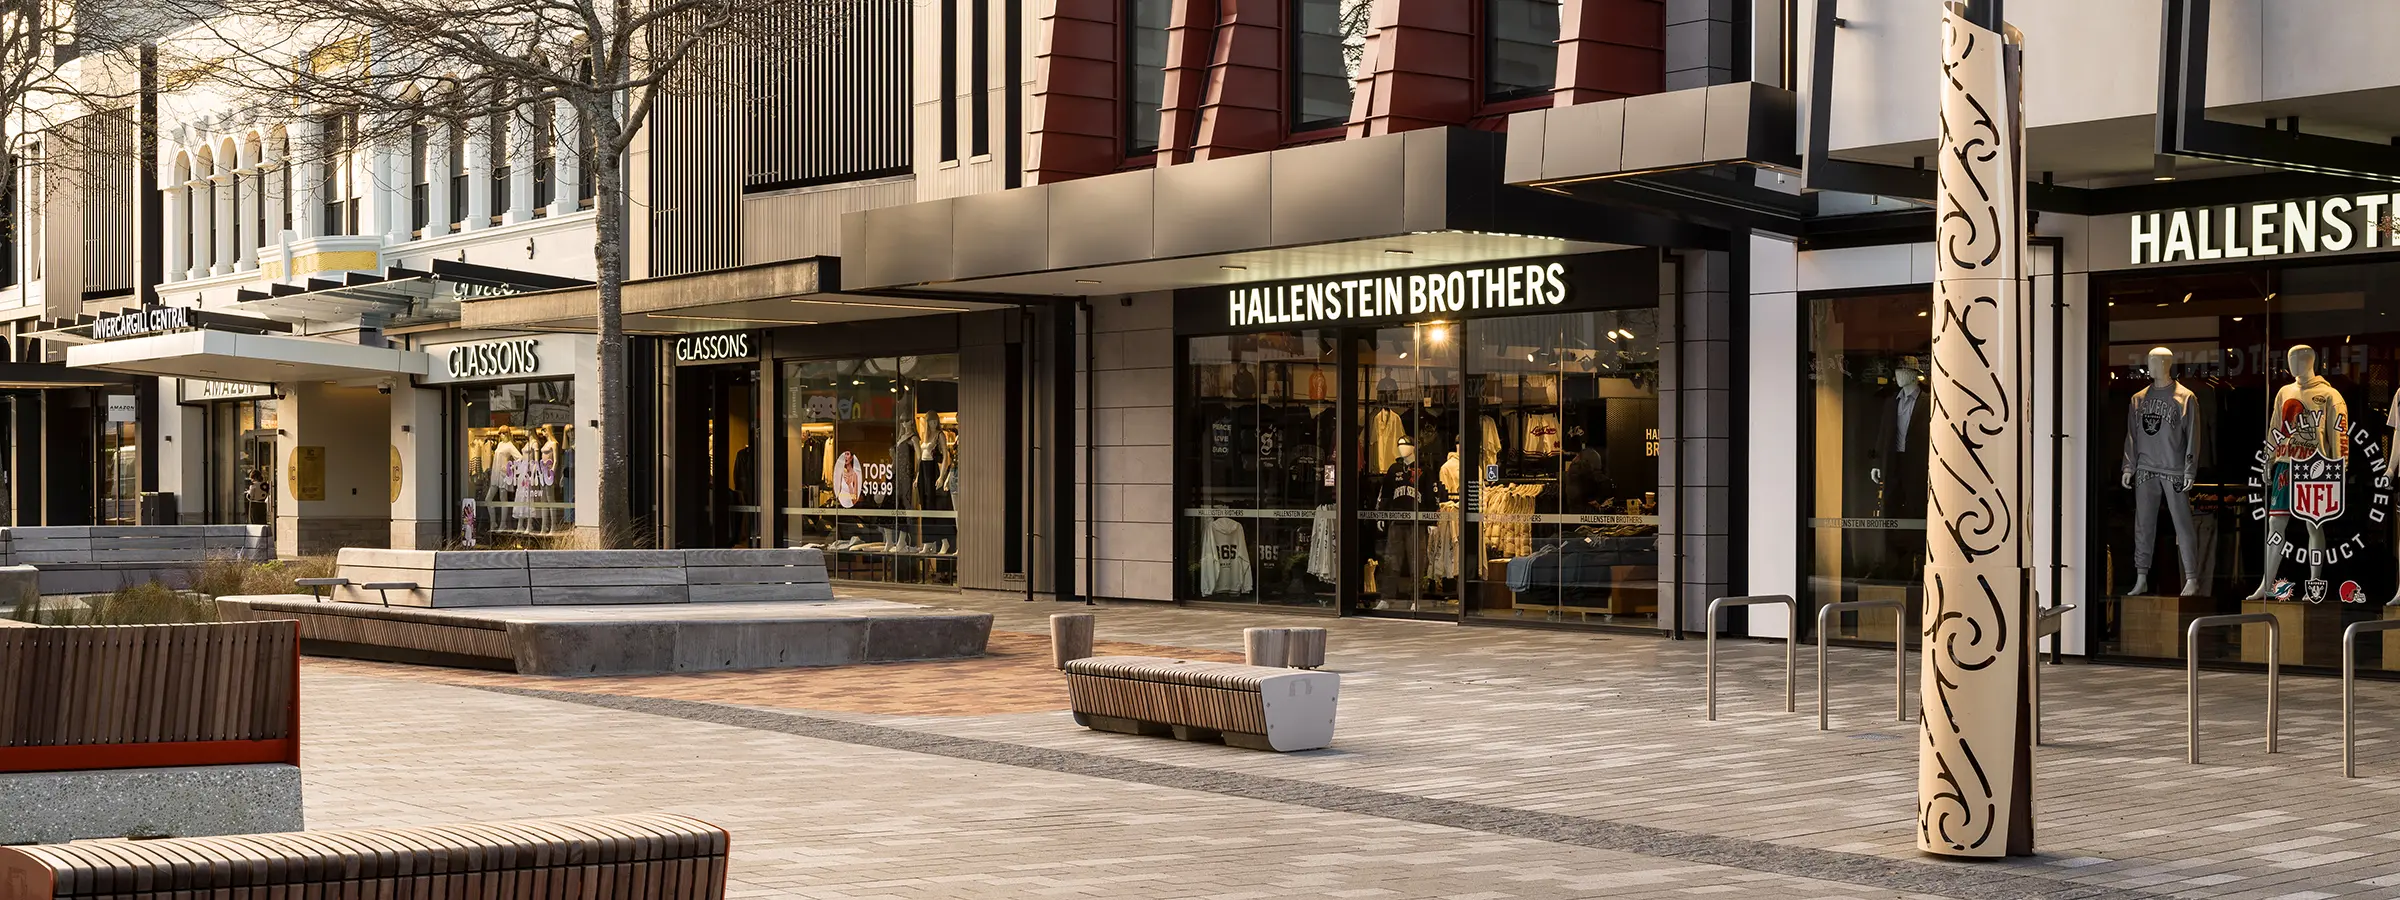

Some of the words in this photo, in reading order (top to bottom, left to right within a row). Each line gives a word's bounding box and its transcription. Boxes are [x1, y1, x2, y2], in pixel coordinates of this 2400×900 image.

[1229, 276, 1402, 326] HALLENSTEIN
[1409, 262, 1566, 314] BROTHERS
[93, 312, 149, 340] INVERCARGILL
[150, 306, 188, 331] CENTRAL
[447, 339, 537, 378] GLASSONS
[676, 333, 748, 360] GLASSONS
[506, 459, 555, 486] SPING
[863, 463, 893, 480] TOPS
[2248, 410, 2324, 521] OFFICIALLY
[2334, 413, 2389, 523] LICENSED
[862, 481, 893, 496] $19.99
[2296, 484, 2338, 517] NFL
[1580, 515, 1615, 523] HALLENSTEIN
[1866, 519, 1899, 528] BROTHERS
[2267, 533, 2365, 566] PRODUCT
